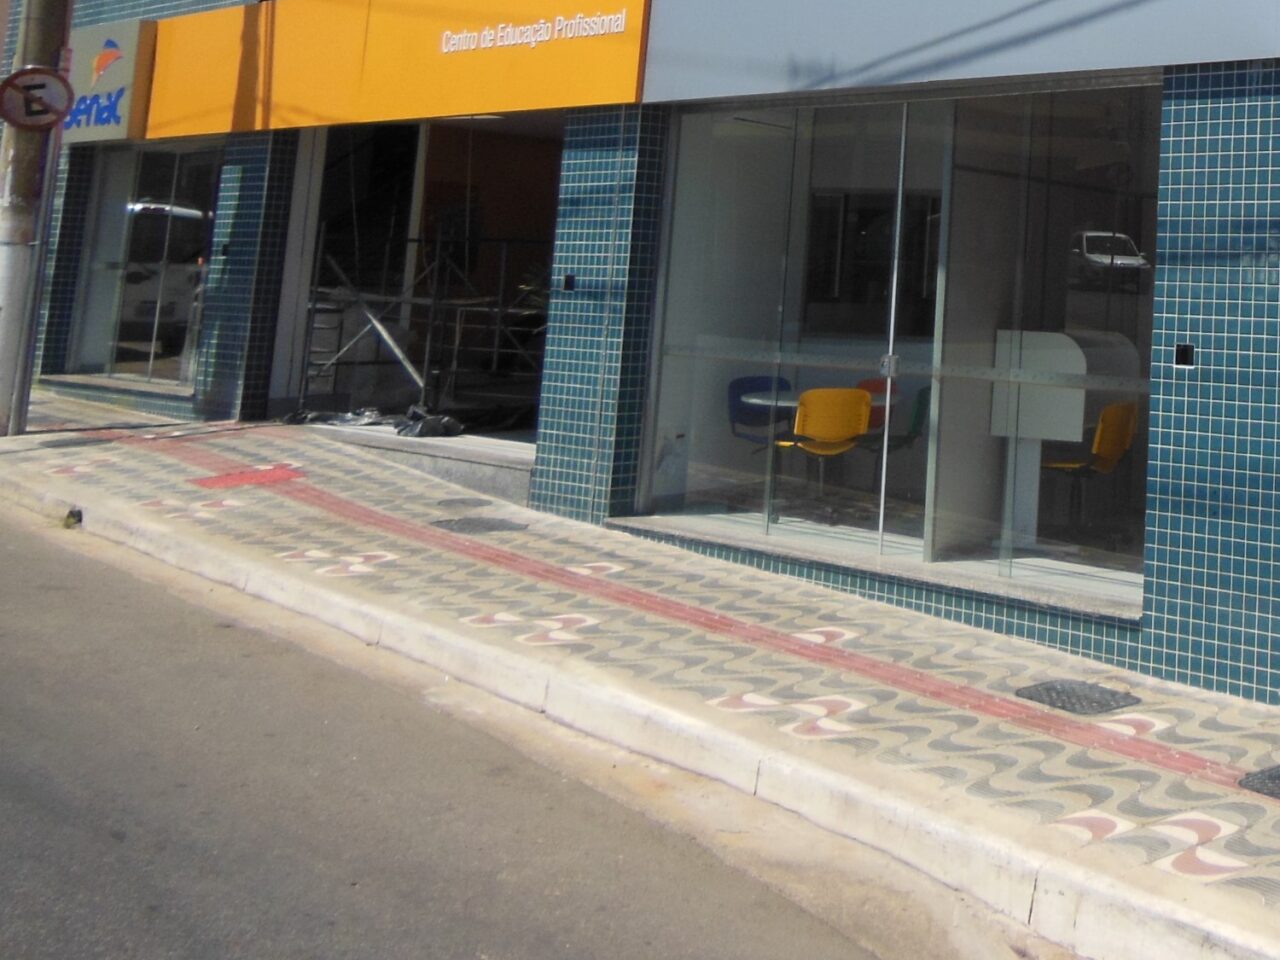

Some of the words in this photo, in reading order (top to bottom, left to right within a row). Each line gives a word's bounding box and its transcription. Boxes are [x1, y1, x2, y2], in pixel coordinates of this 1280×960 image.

[442, 30, 478, 53] Centro
[481, 25, 495, 48] de
[497, 20, 551, 48] Educação
[554, 8, 627, 38] Profissional
[22, 83, 49, 117] E
